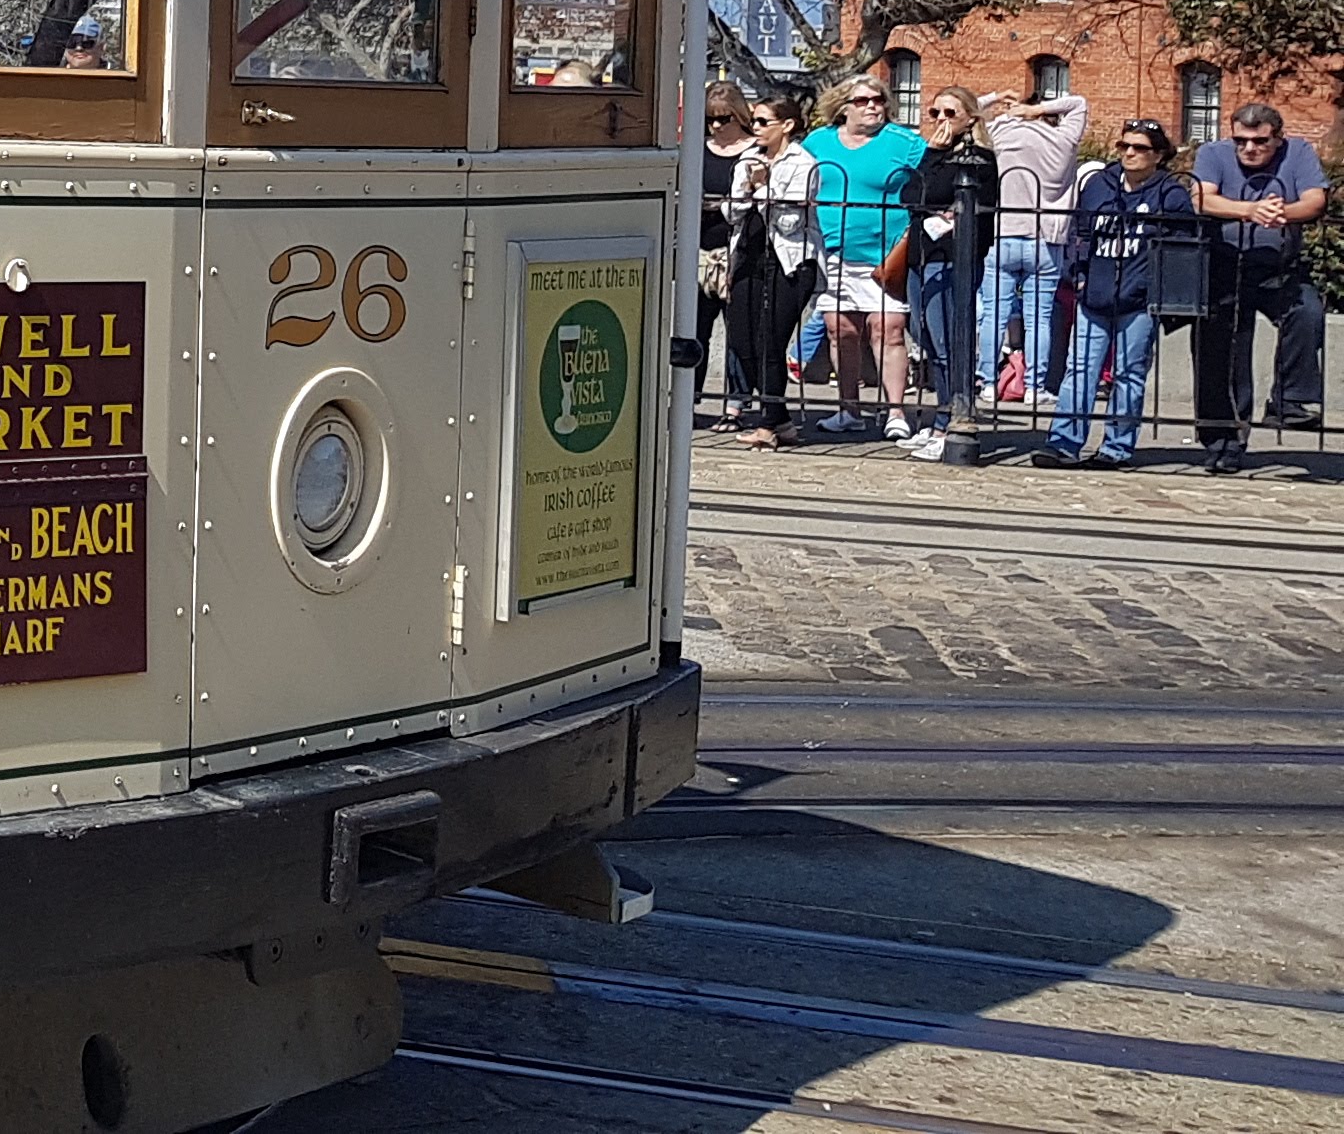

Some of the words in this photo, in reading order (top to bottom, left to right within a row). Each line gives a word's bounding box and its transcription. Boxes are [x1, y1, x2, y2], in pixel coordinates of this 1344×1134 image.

[1095, 237, 1140, 257] MOM
[264, 243, 408, 350] 26
[30, 502, 134, 560] BEACH
